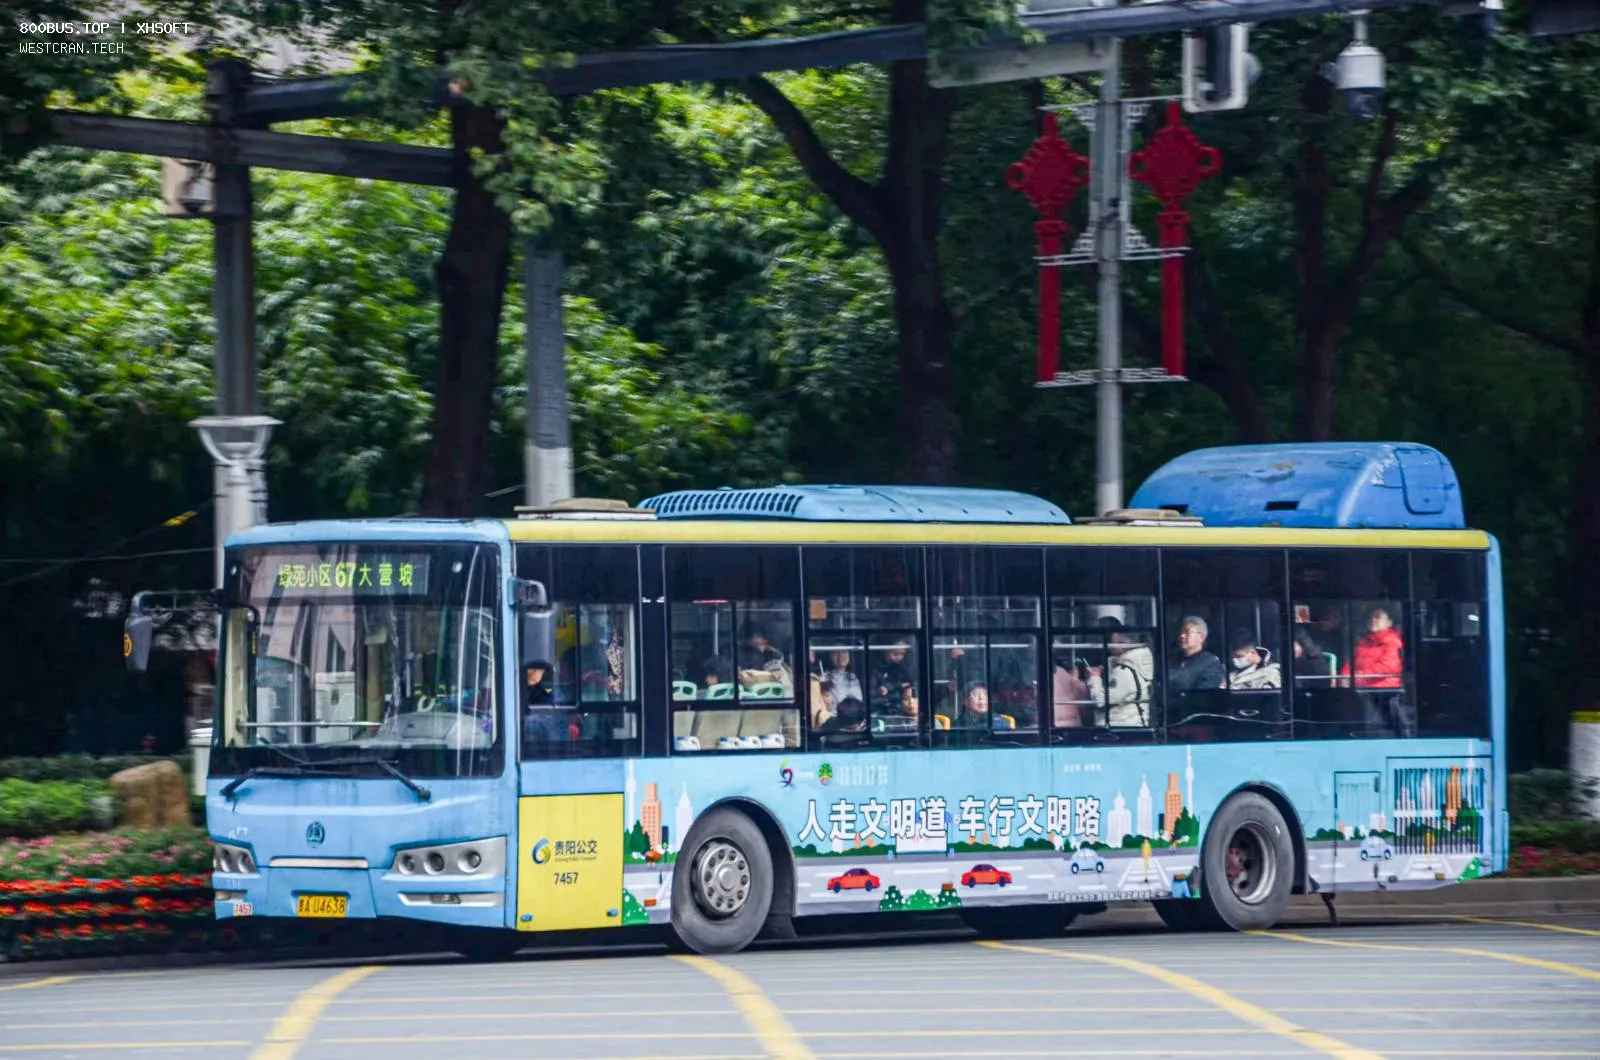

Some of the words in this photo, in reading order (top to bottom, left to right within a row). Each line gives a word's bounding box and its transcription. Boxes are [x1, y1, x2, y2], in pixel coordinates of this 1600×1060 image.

[278, 563, 332, 588] 绿苑小区
[335, 562, 356, 587] 67
[359, 562, 413, 587] 大营坡
[798, 796, 947, 842] 人走文明道
[958, 794, 1101, 837] 车行文明路
[554, 839, 598, 856] 贵阳公交
[553, 872, 579, 885] 7457
